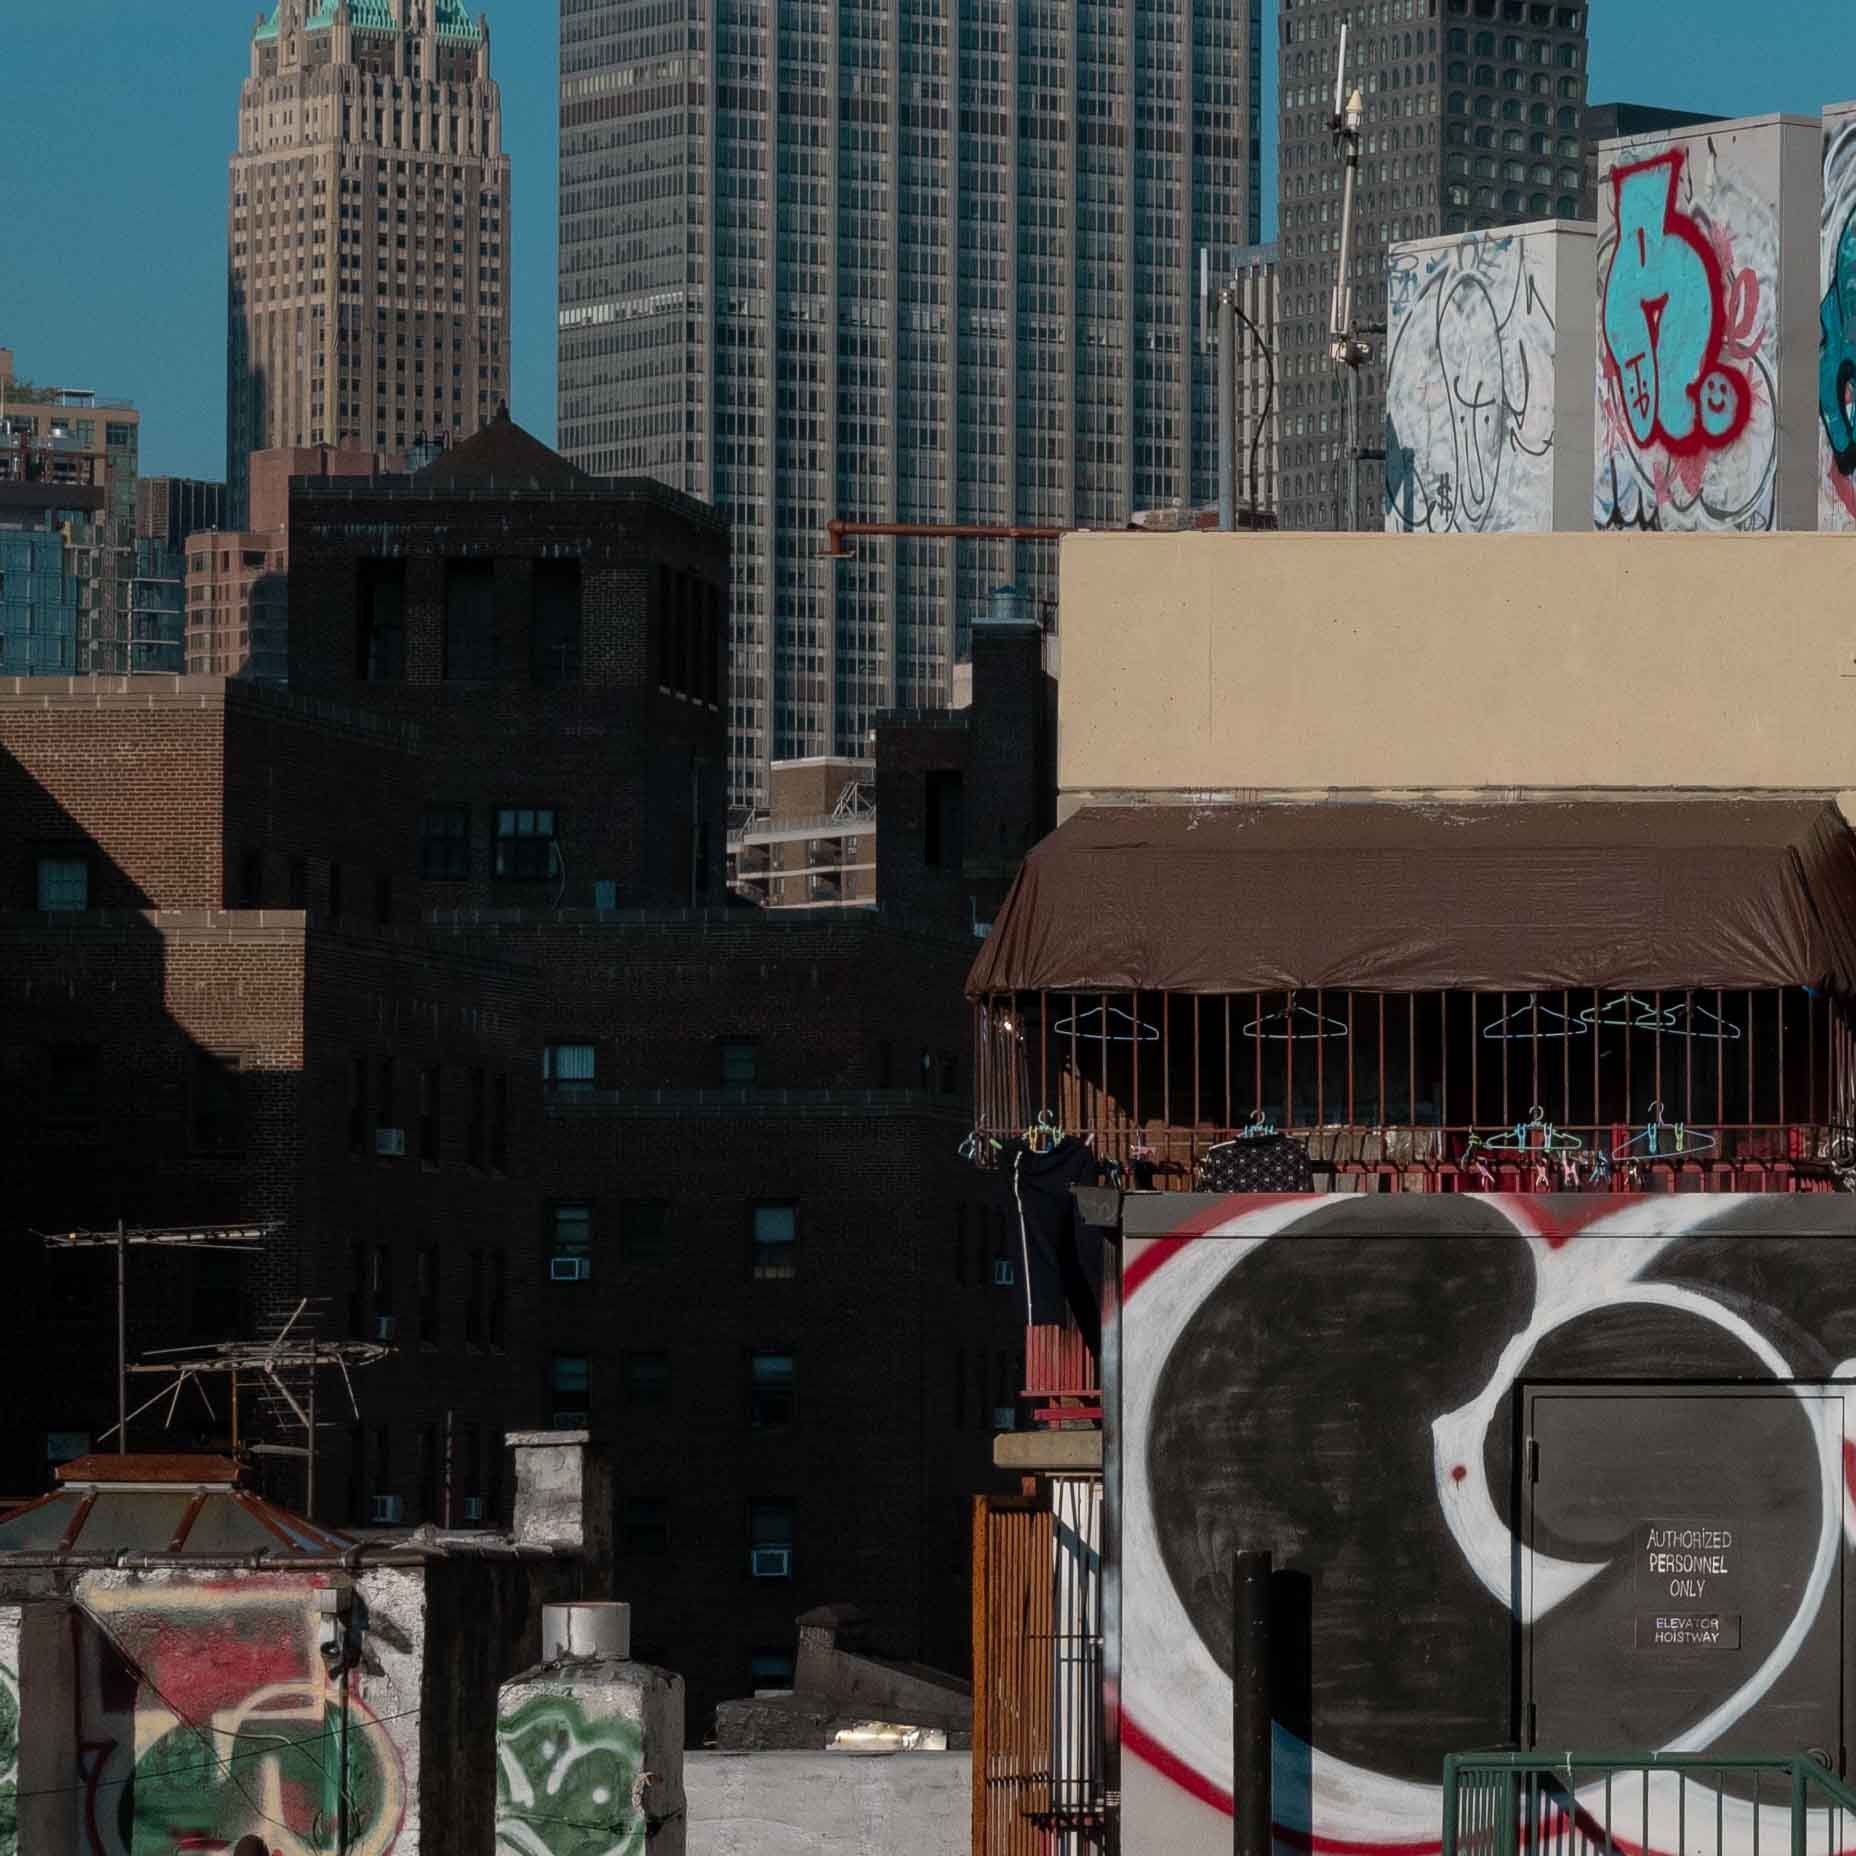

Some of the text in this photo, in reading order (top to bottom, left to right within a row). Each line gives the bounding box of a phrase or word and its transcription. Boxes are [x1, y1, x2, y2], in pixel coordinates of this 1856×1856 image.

[1646, 1528, 1732, 1551] AUTHORIZED
[1649, 1552, 1728, 1574] PERSONNEL
[1670, 1579, 1706, 1598] ONLY
[1656, 1617, 1719, 1631] ELEVATOR
[1655, 1630, 1720, 1643] HOISTWAY
